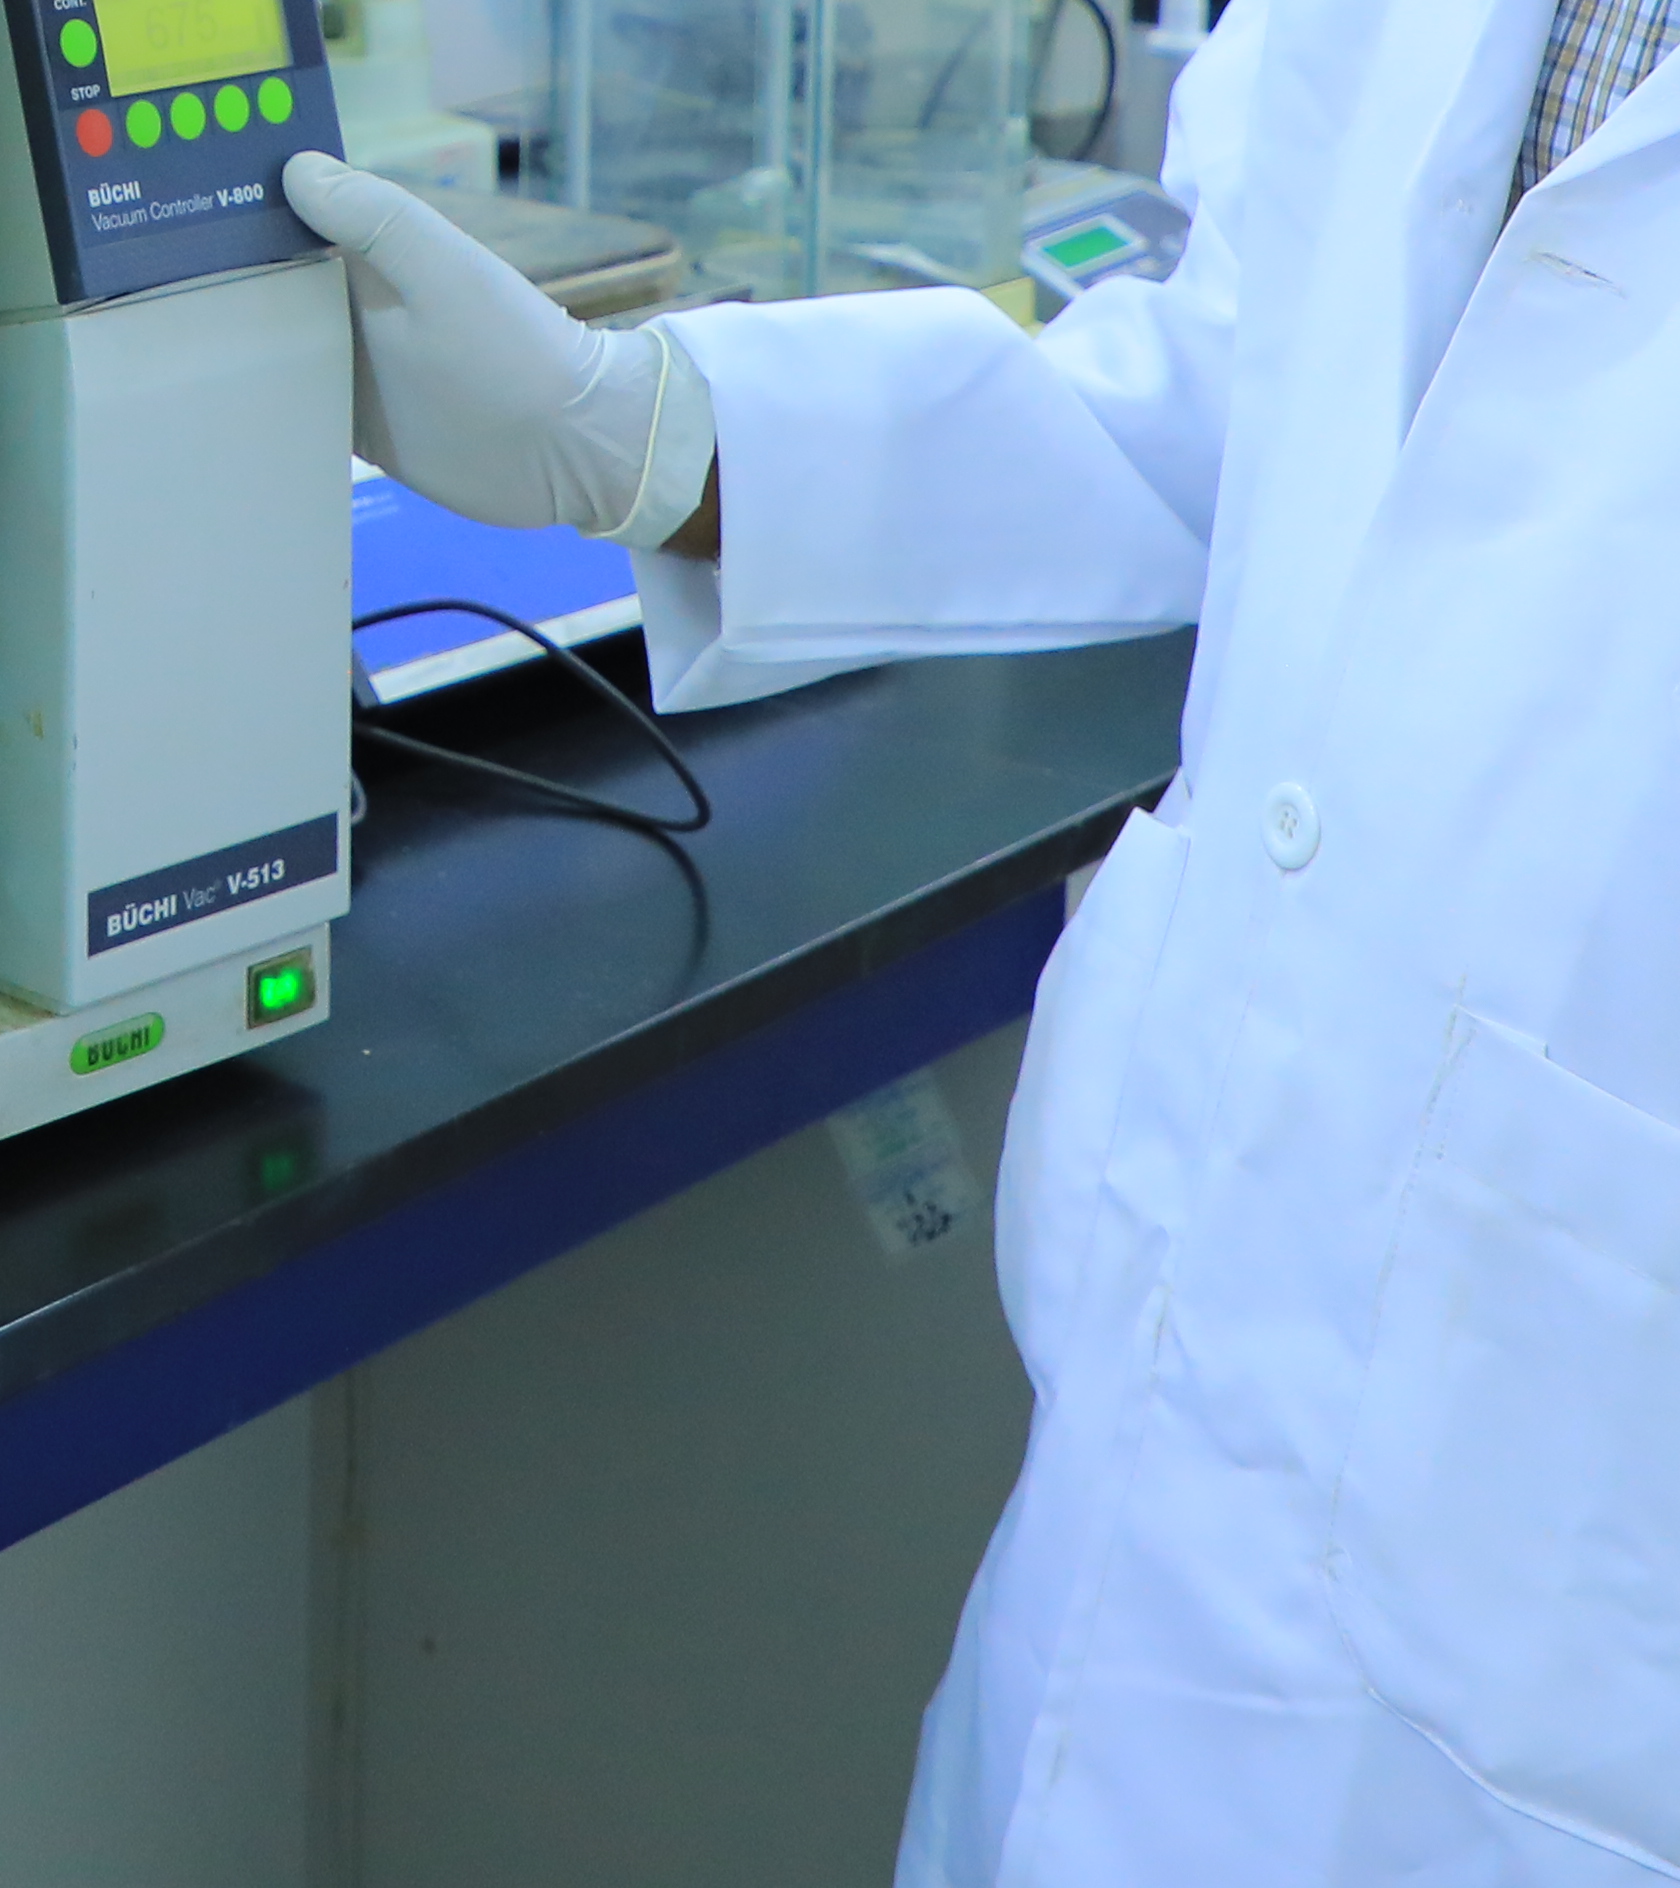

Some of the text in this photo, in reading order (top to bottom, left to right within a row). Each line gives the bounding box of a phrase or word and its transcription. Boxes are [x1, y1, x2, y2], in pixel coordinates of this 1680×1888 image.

[71, 84, 101, 101] STOP
[88, 181, 141, 208] BÜCHI
[91, 183, 265, 232] Vacuum Controller V-800
[107, 894, 177, 937] BÜCHI
[226, 859, 286, 896] V-513
